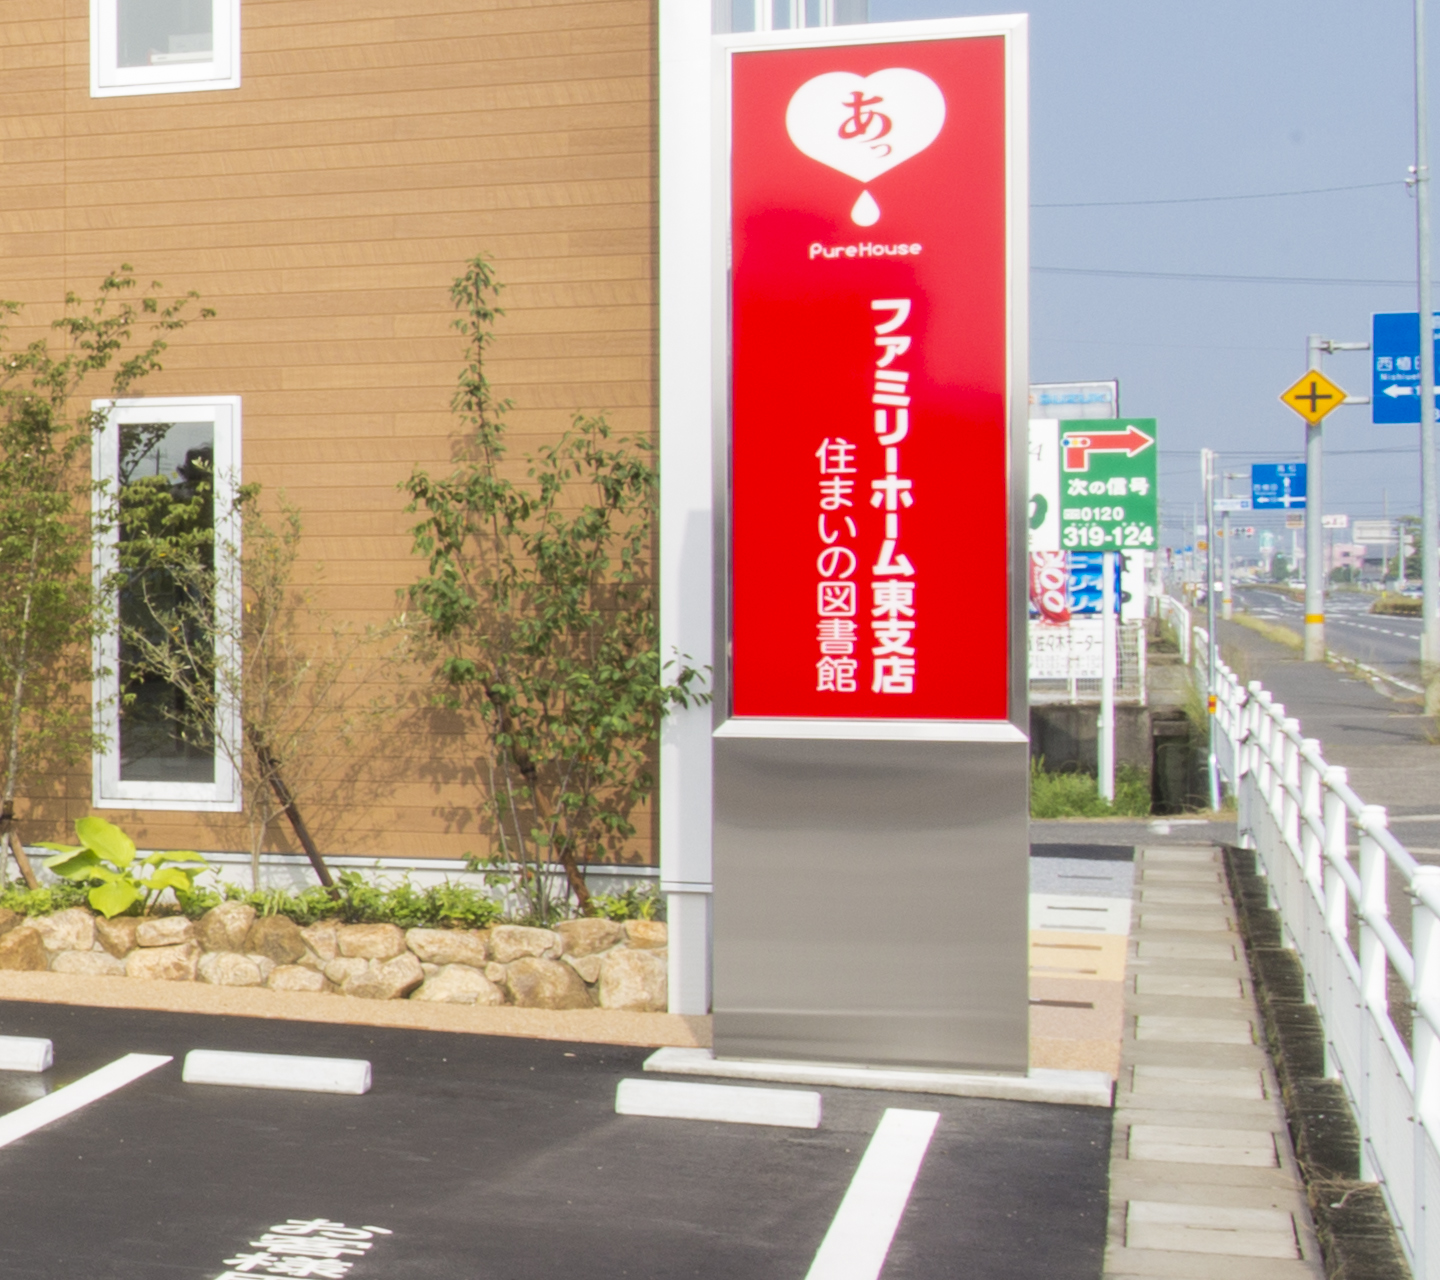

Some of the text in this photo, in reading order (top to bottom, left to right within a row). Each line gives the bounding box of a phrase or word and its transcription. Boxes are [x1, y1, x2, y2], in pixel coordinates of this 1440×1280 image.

[838, 91, 893, 158] あっ
[809, 242, 923, 260] PureHouse
[870, 298, 916, 694] ファミリーホーム東支店
[1068, 477, 1149, 496] 次の信号
[1081, 507, 1125, 521] 0120
[1063, 526, 1154, 546] 319-124
[815, 437, 857, 693] 住まいの図書館
